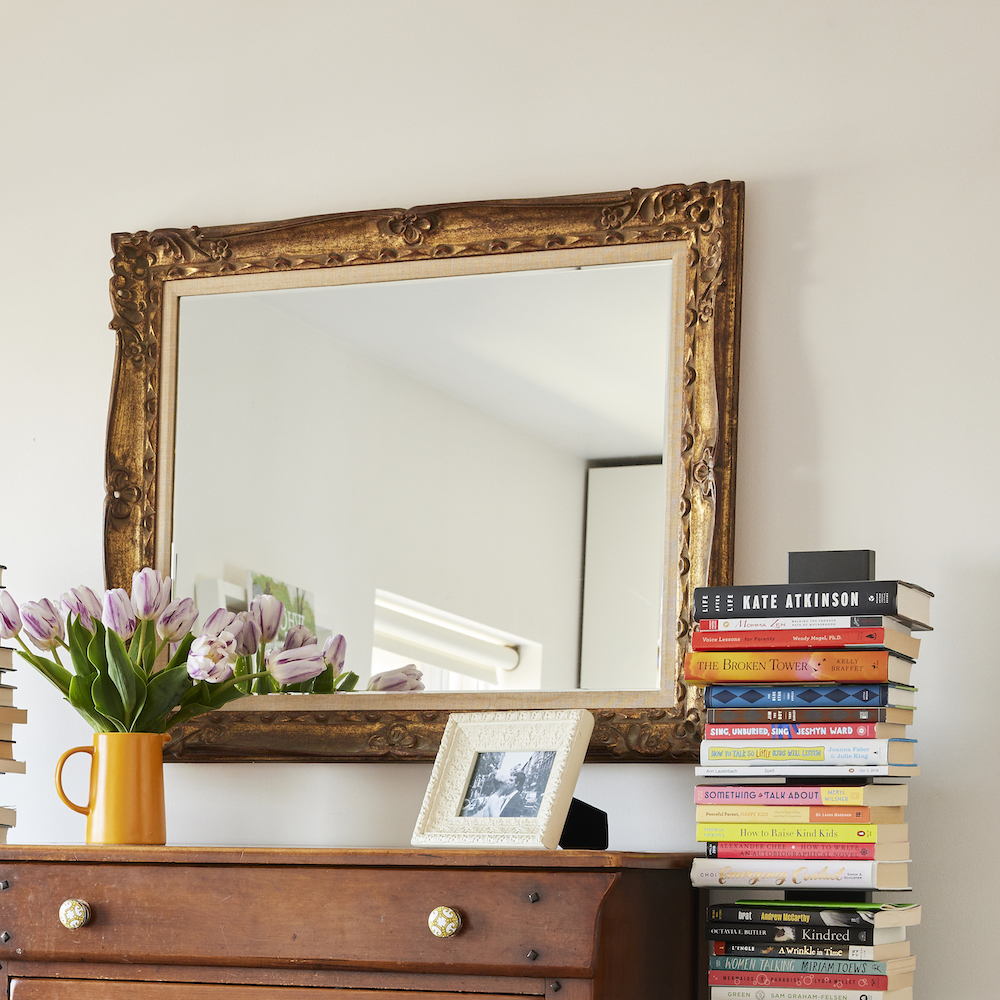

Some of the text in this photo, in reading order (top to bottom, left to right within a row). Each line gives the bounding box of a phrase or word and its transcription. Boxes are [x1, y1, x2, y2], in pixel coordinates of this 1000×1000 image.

[743, 594, 778, 610] KATE
[786, 592, 859, 609] ATKINSON
[697, 661, 718, 670] THE
[710, 726, 789, 737] SING, UNBURIED, SING
[797, 726, 853, 735] JESMYN WARD
[718, 866, 845, 885] Emergency Contact
[802, 929, 850, 941] Kindred
[786, 946, 816, 955] Wrinkle
[825, 947, 842, 956] Time
[725, 958, 867, 973] WOMEN TALKING MIRIAM TOEWS
